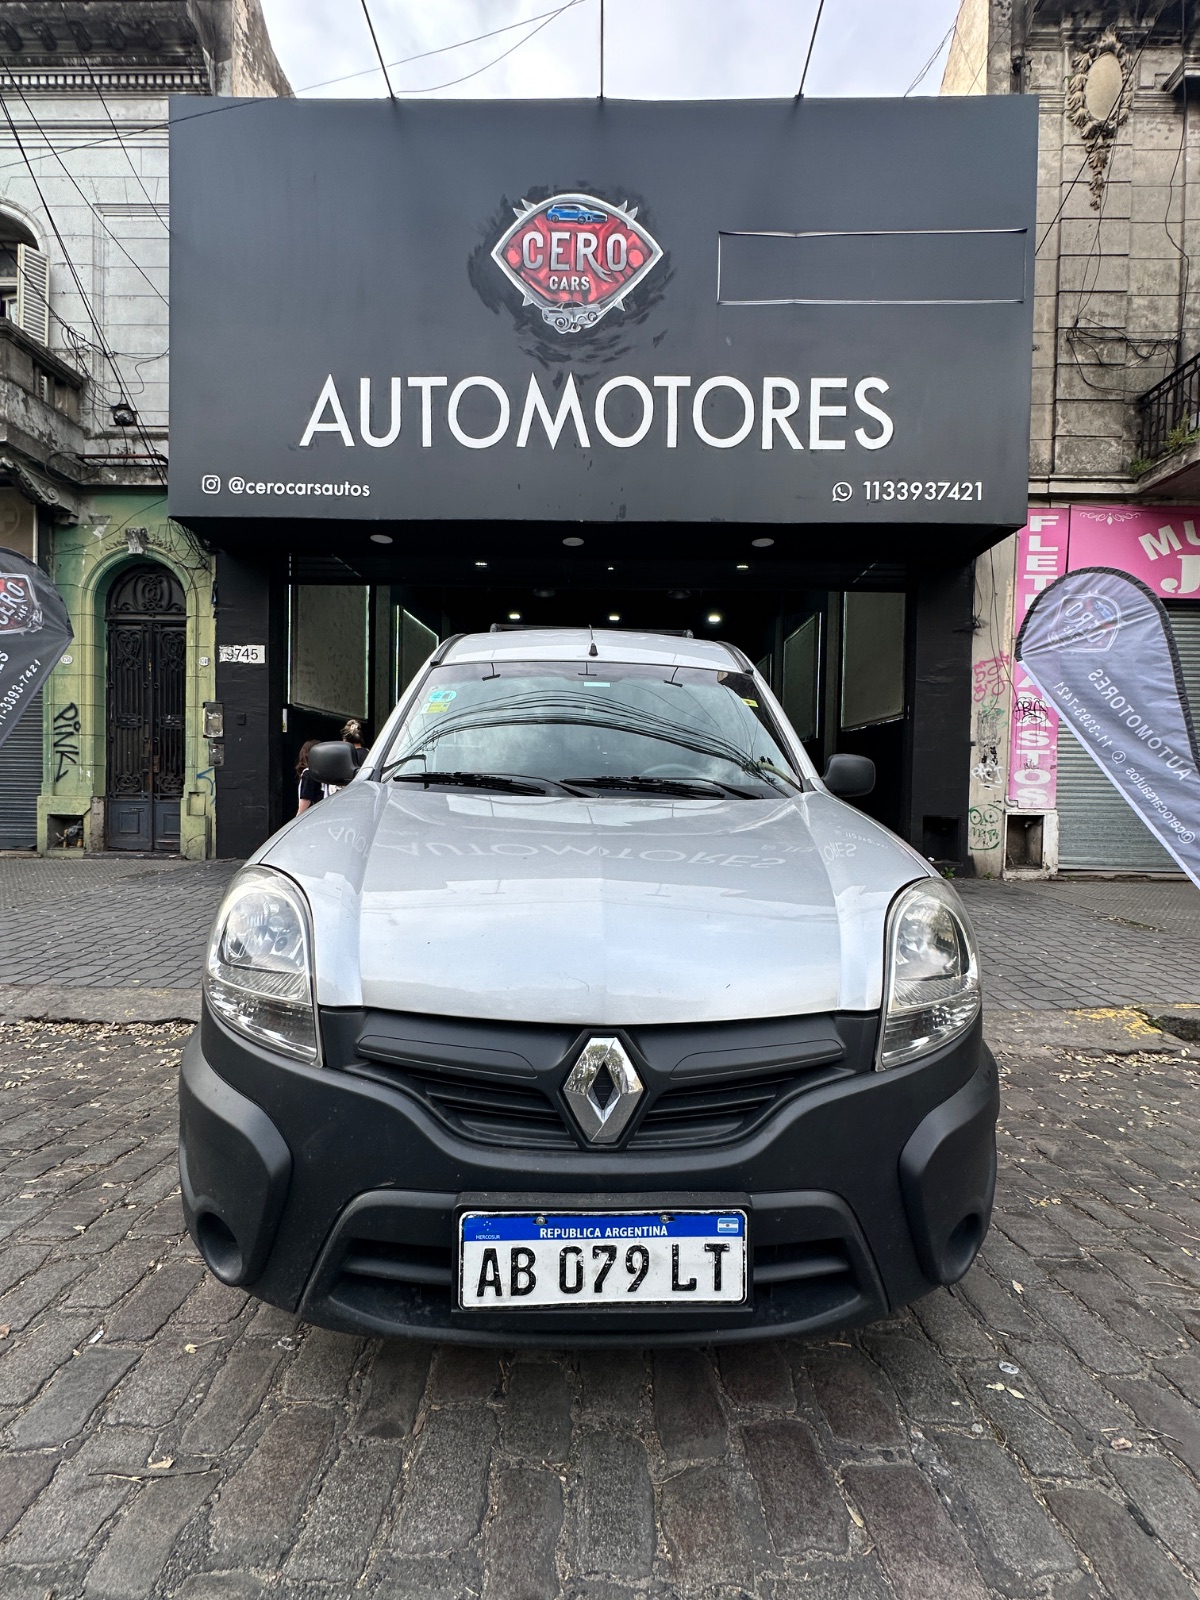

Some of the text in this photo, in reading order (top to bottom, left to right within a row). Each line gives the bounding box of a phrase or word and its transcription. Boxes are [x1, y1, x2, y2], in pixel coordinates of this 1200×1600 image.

[522, 231, 628, 282] CERO
[549, 276, 590, 290] CARS
[299, 373, 894, 450] AUTOMOTORES
[228, 477, 371, 497] @cerocarsautos
[863, 481, 983, 501] 1133937421
[540, 1225, 669, 1239] REPUBLICA ARGENTINA
[476, 1243, 731, 1297] AB 079 LT
